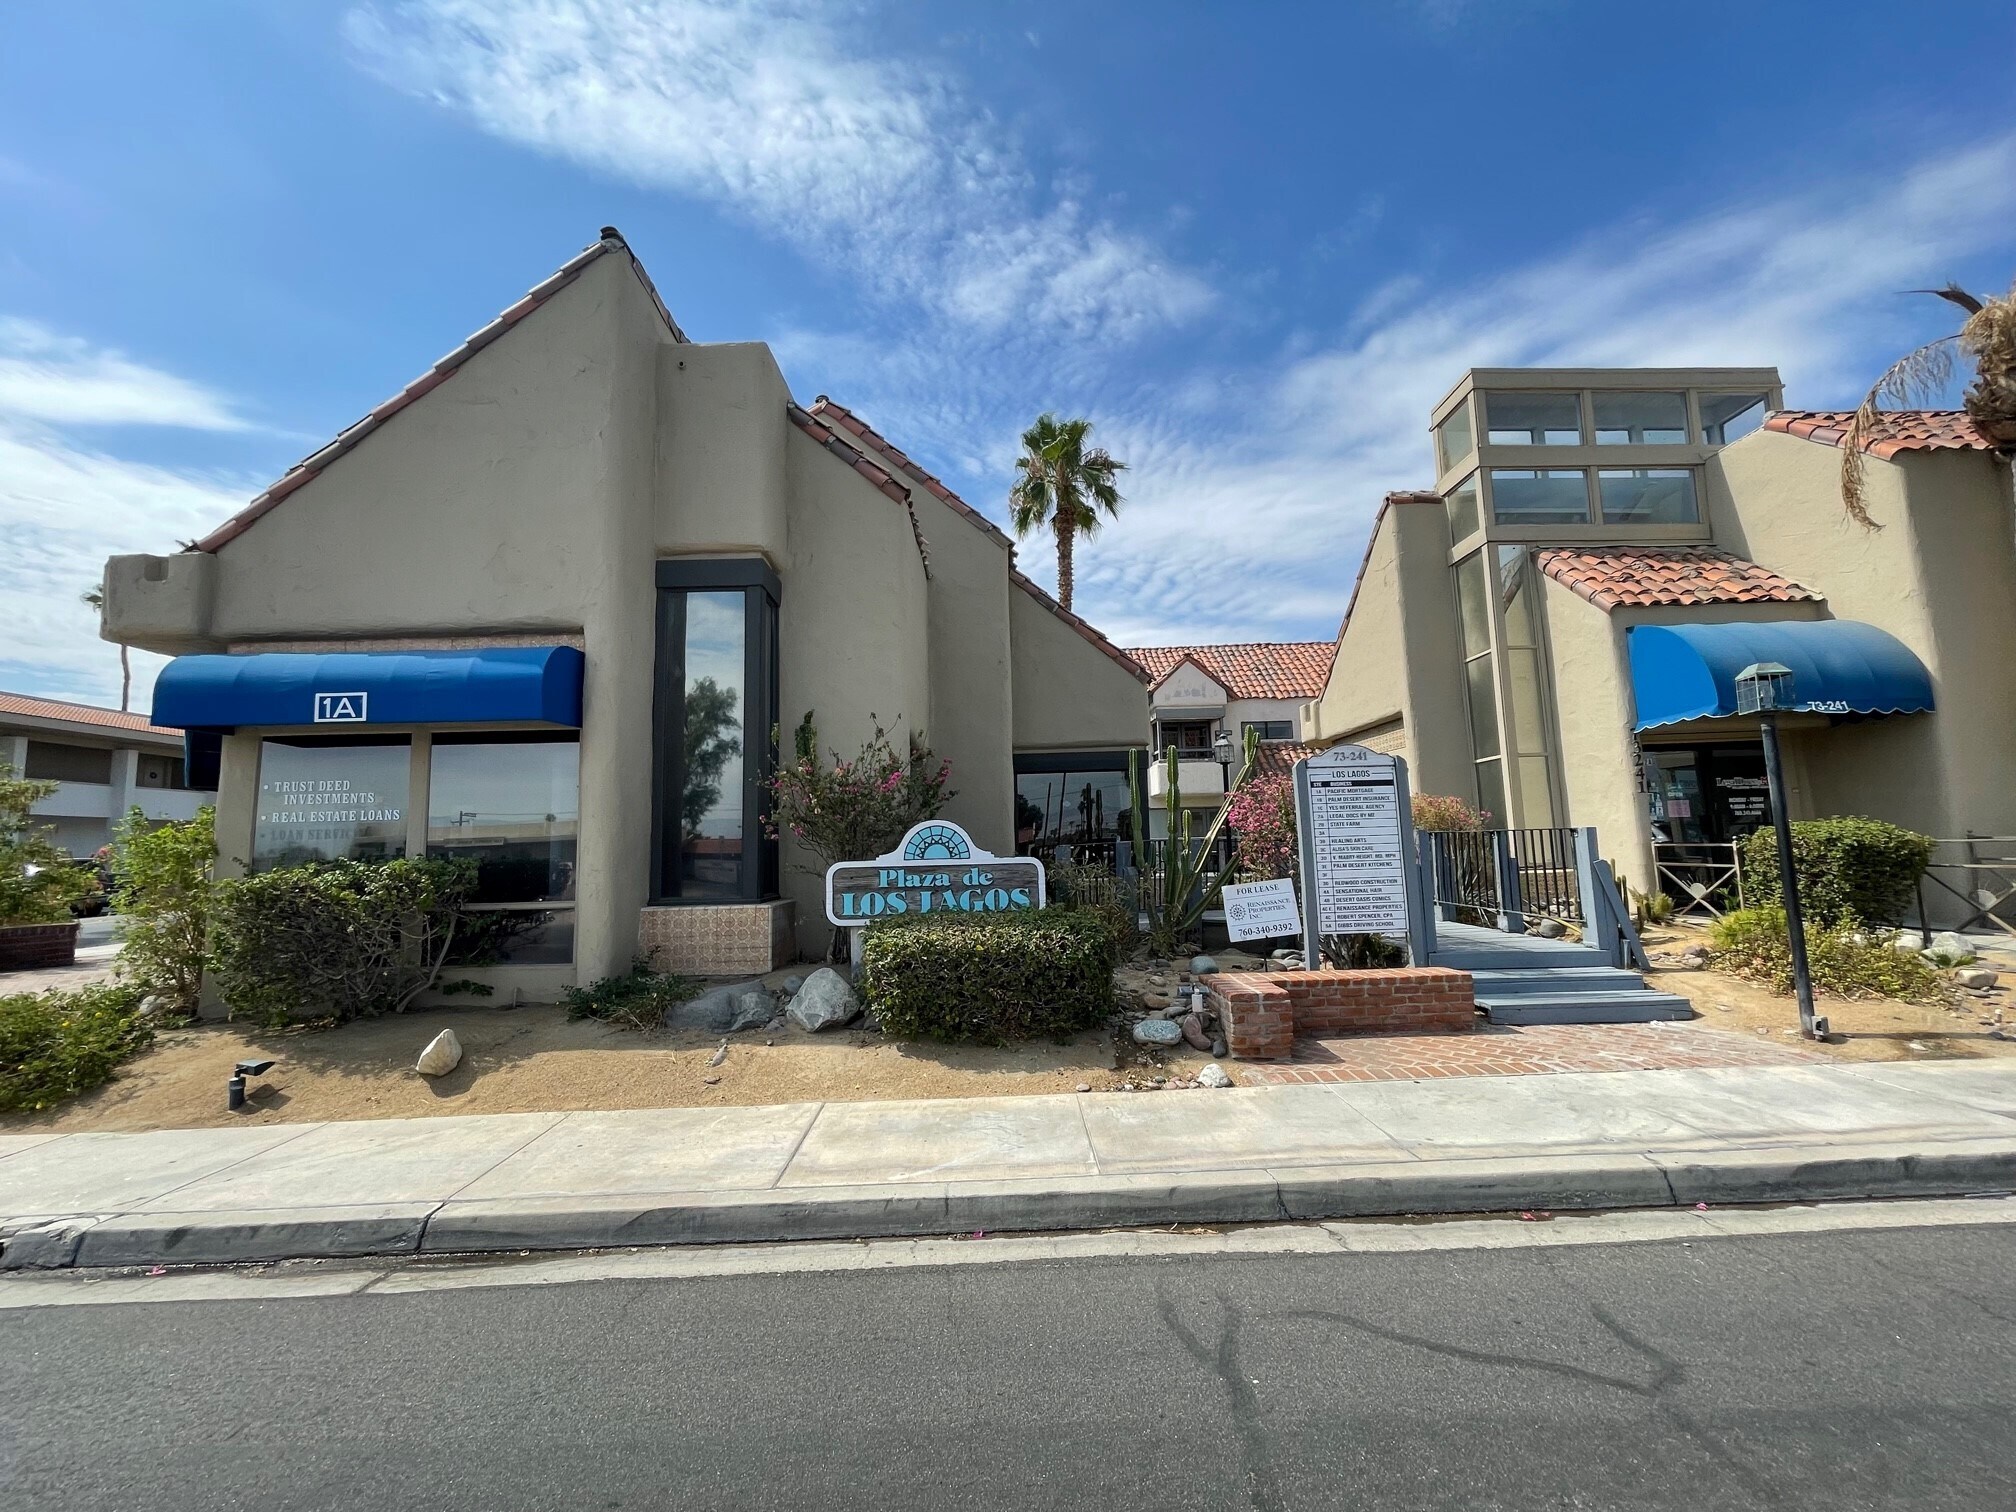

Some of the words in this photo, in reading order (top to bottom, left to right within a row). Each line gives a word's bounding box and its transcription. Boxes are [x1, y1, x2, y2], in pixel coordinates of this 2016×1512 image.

[323, 697, 356, 718] 1A
[1807, 701, 1849, 710] 73-241
[1333, 752, 1367, 761] 73-241
[1347, 770, 1371, 778] LAGOS
[274, 780, 315, 793] TRUST
[319, 780, 350, 791] DEED
[284, 792, 375, 805] INVESTMENTS
[272, 812, 306, 823] REAL
[310, 810, 356, 822] ESTATE
[360, 809, 400, 821] LOANS
[270, 829, 304, 841] LOAN
[878, 868, 950, 888] Plaza
[963, 867, 994, 886] de
[1236, 886, 1253, 896] FOR
[1254, 884, 1280, 893] LEASE
[841, 891, 908, 916] LOS
[1247, 898, 1291, 908] RENAISSANCE
[1238, 923, 1293, 937] 760-340-9392
